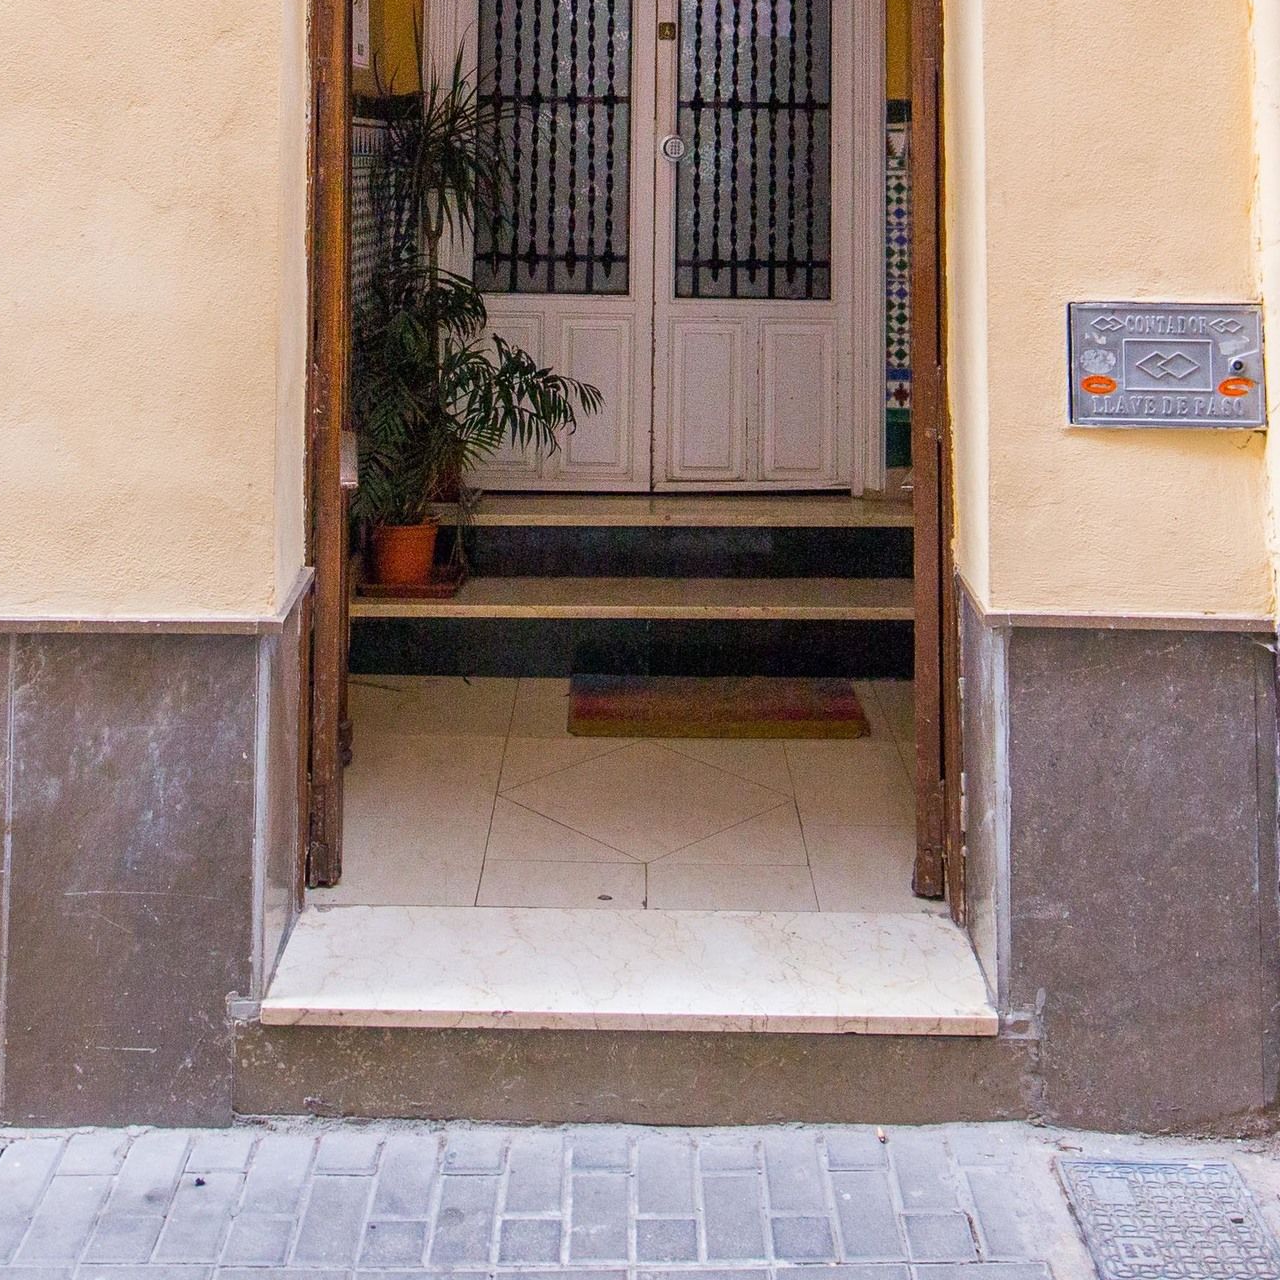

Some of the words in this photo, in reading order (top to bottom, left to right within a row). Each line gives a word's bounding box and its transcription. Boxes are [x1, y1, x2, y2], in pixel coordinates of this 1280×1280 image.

[1125, 315, 1210, 335] CONTADOR
[1091, 395, 1156, 414] LLAVE
[1161, 396, 1188, 415] DE
[1193, 397, 1244, 416] PASO
